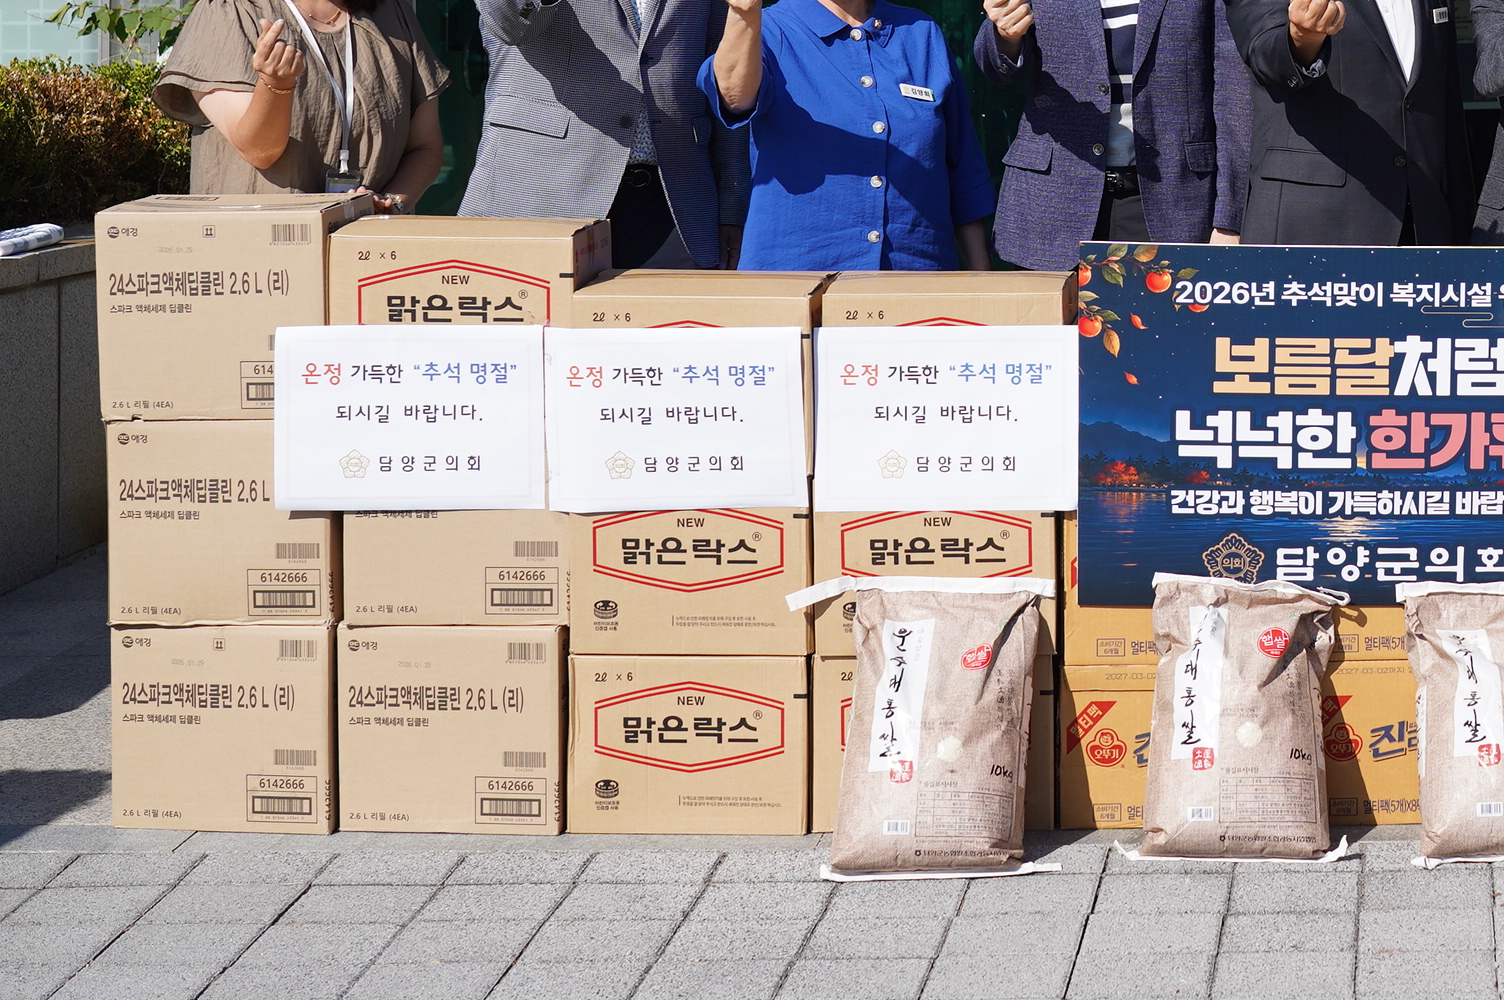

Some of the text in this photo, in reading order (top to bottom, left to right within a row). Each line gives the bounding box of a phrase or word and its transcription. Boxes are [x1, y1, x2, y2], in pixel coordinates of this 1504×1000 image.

[121, 227, 138, 237] 애경
[109, 268, 289, 297] 24스파크액체딥클린 2.6 L (리)
[441, 275, 470, 285] NEW
[1175, 281, 1277, 306] 2026년
[1280, 281, 1384, 309] 추석맞이
[1390, 281, 1492, 309] 복지시설
[109, 303, 193, 314] 스파크 액체세제 딥클린
[386, 294, 525, 324] 맑은락스
[300, 362, 342, 386] 온정
[350, 363, 404, 385] 가득한
[565, 365, 603, 389] 온정
[611, 366, 664, 387] 가득한
[839, 363, 879, 387] 온정
[887, 364, 940, 385] 가득한
[112, 400, 174, 410] 2.6 L 리필 (4EA)
[335, 404, 483, 424] 되시길 바랍니다.
[599, 405, 744, 426] 되시길 바랍니다.
[873, 404, 1018, 425] 되시길 바랍니다.
[1175, 408, 1357, 470] 넉넉한
[379, 455, 481, 473] 담양군의회
[643, 455, 744, 473] 담양군의회
[916, 455, 1016, 473] 담양군의회
[119, 478, 270, 504] 24스파크액체딥클린 2.6 L
[1170, 490, 1244, 516] 건강과
[1249, 490, 1323, 516] 행복이
[1329, 490, 1450, 516] 가득하시길
[676, 517, 705, 528] NEW
[923, 516, 952, 528] NEW
[621, 537, 758, 566] 맑은락스
[868, 536, 1008, 566] 맑은락스
[1221, 554, 1245, 570] 의회
[260, 572, 308, 583] 6142666
[498, 570, 546, 581] 6142666
[1100, 640, 1123, 648] 소비기간
[1260, 633, 1290, 649] 햅쌀
[122, 682, 295, 712] 24스파크액체딥클린 2.6 L (리)
[348, 685, 524, 713] 24스파크액체딥클린 2.6 L (리)
[677, 696, 706, 706] NEW
[122, 714, 201, 725] 스파크 액체세제 딥클린
[622, 715, 759, 744] 맑은락스
[1094, 748, 1120, 760] 오뚜기
[1289, 748, 1313, 766] 10kg
[990, 764, 1014, 784] 10kg
[259, 778, 305, 790] 6142666
[488, 780, 534, 791] 6142666
